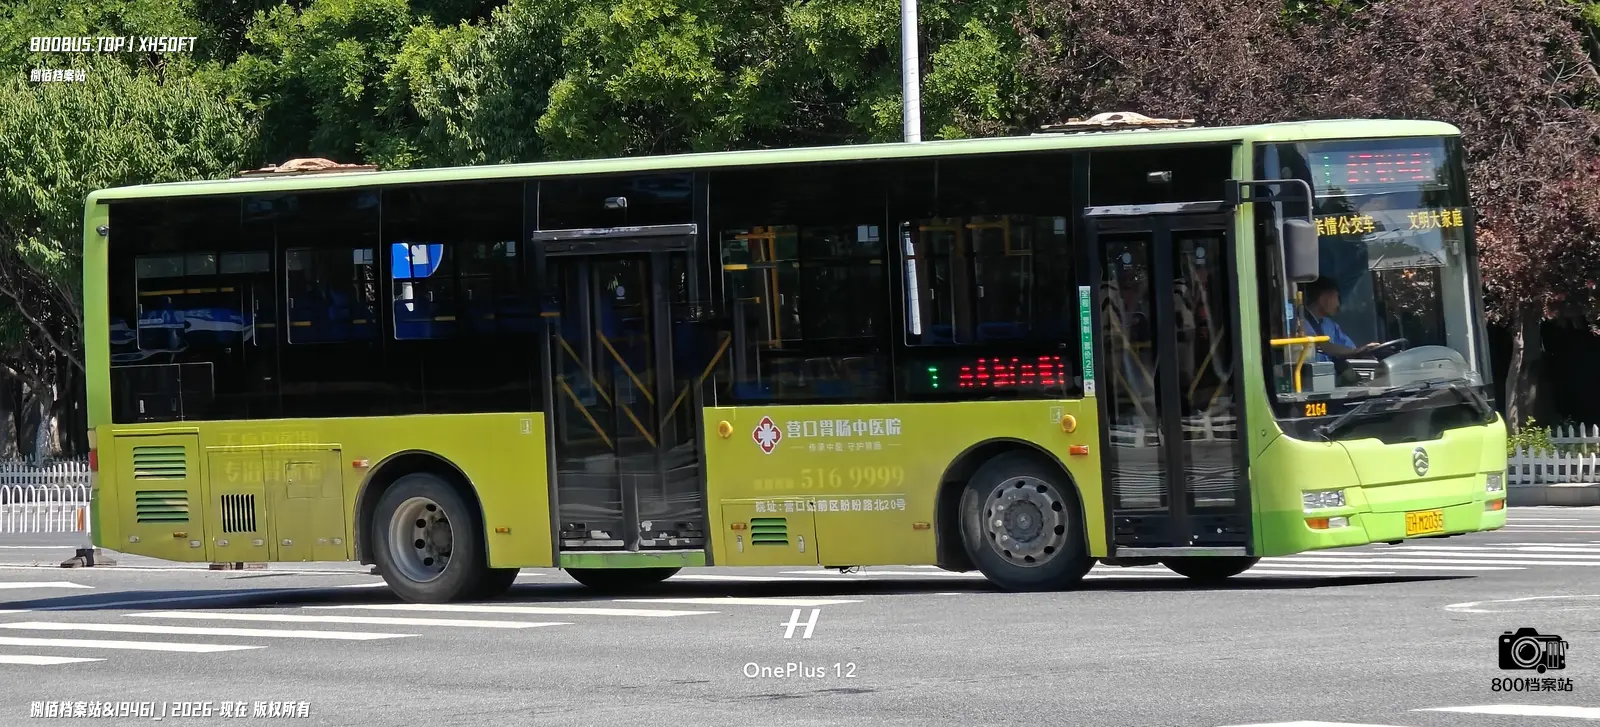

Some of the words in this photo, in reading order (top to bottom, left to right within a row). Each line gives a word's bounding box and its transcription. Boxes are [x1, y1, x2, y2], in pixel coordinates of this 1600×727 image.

[1407, 208, 1464, 231] 文明大家庭
[1305, 402, 1327, 417] 2164
[786, 418, 902, 438] 营口胃肠中医院
[801, 468, 842, 489] 516
[849, 465, 905, 488] 9999
